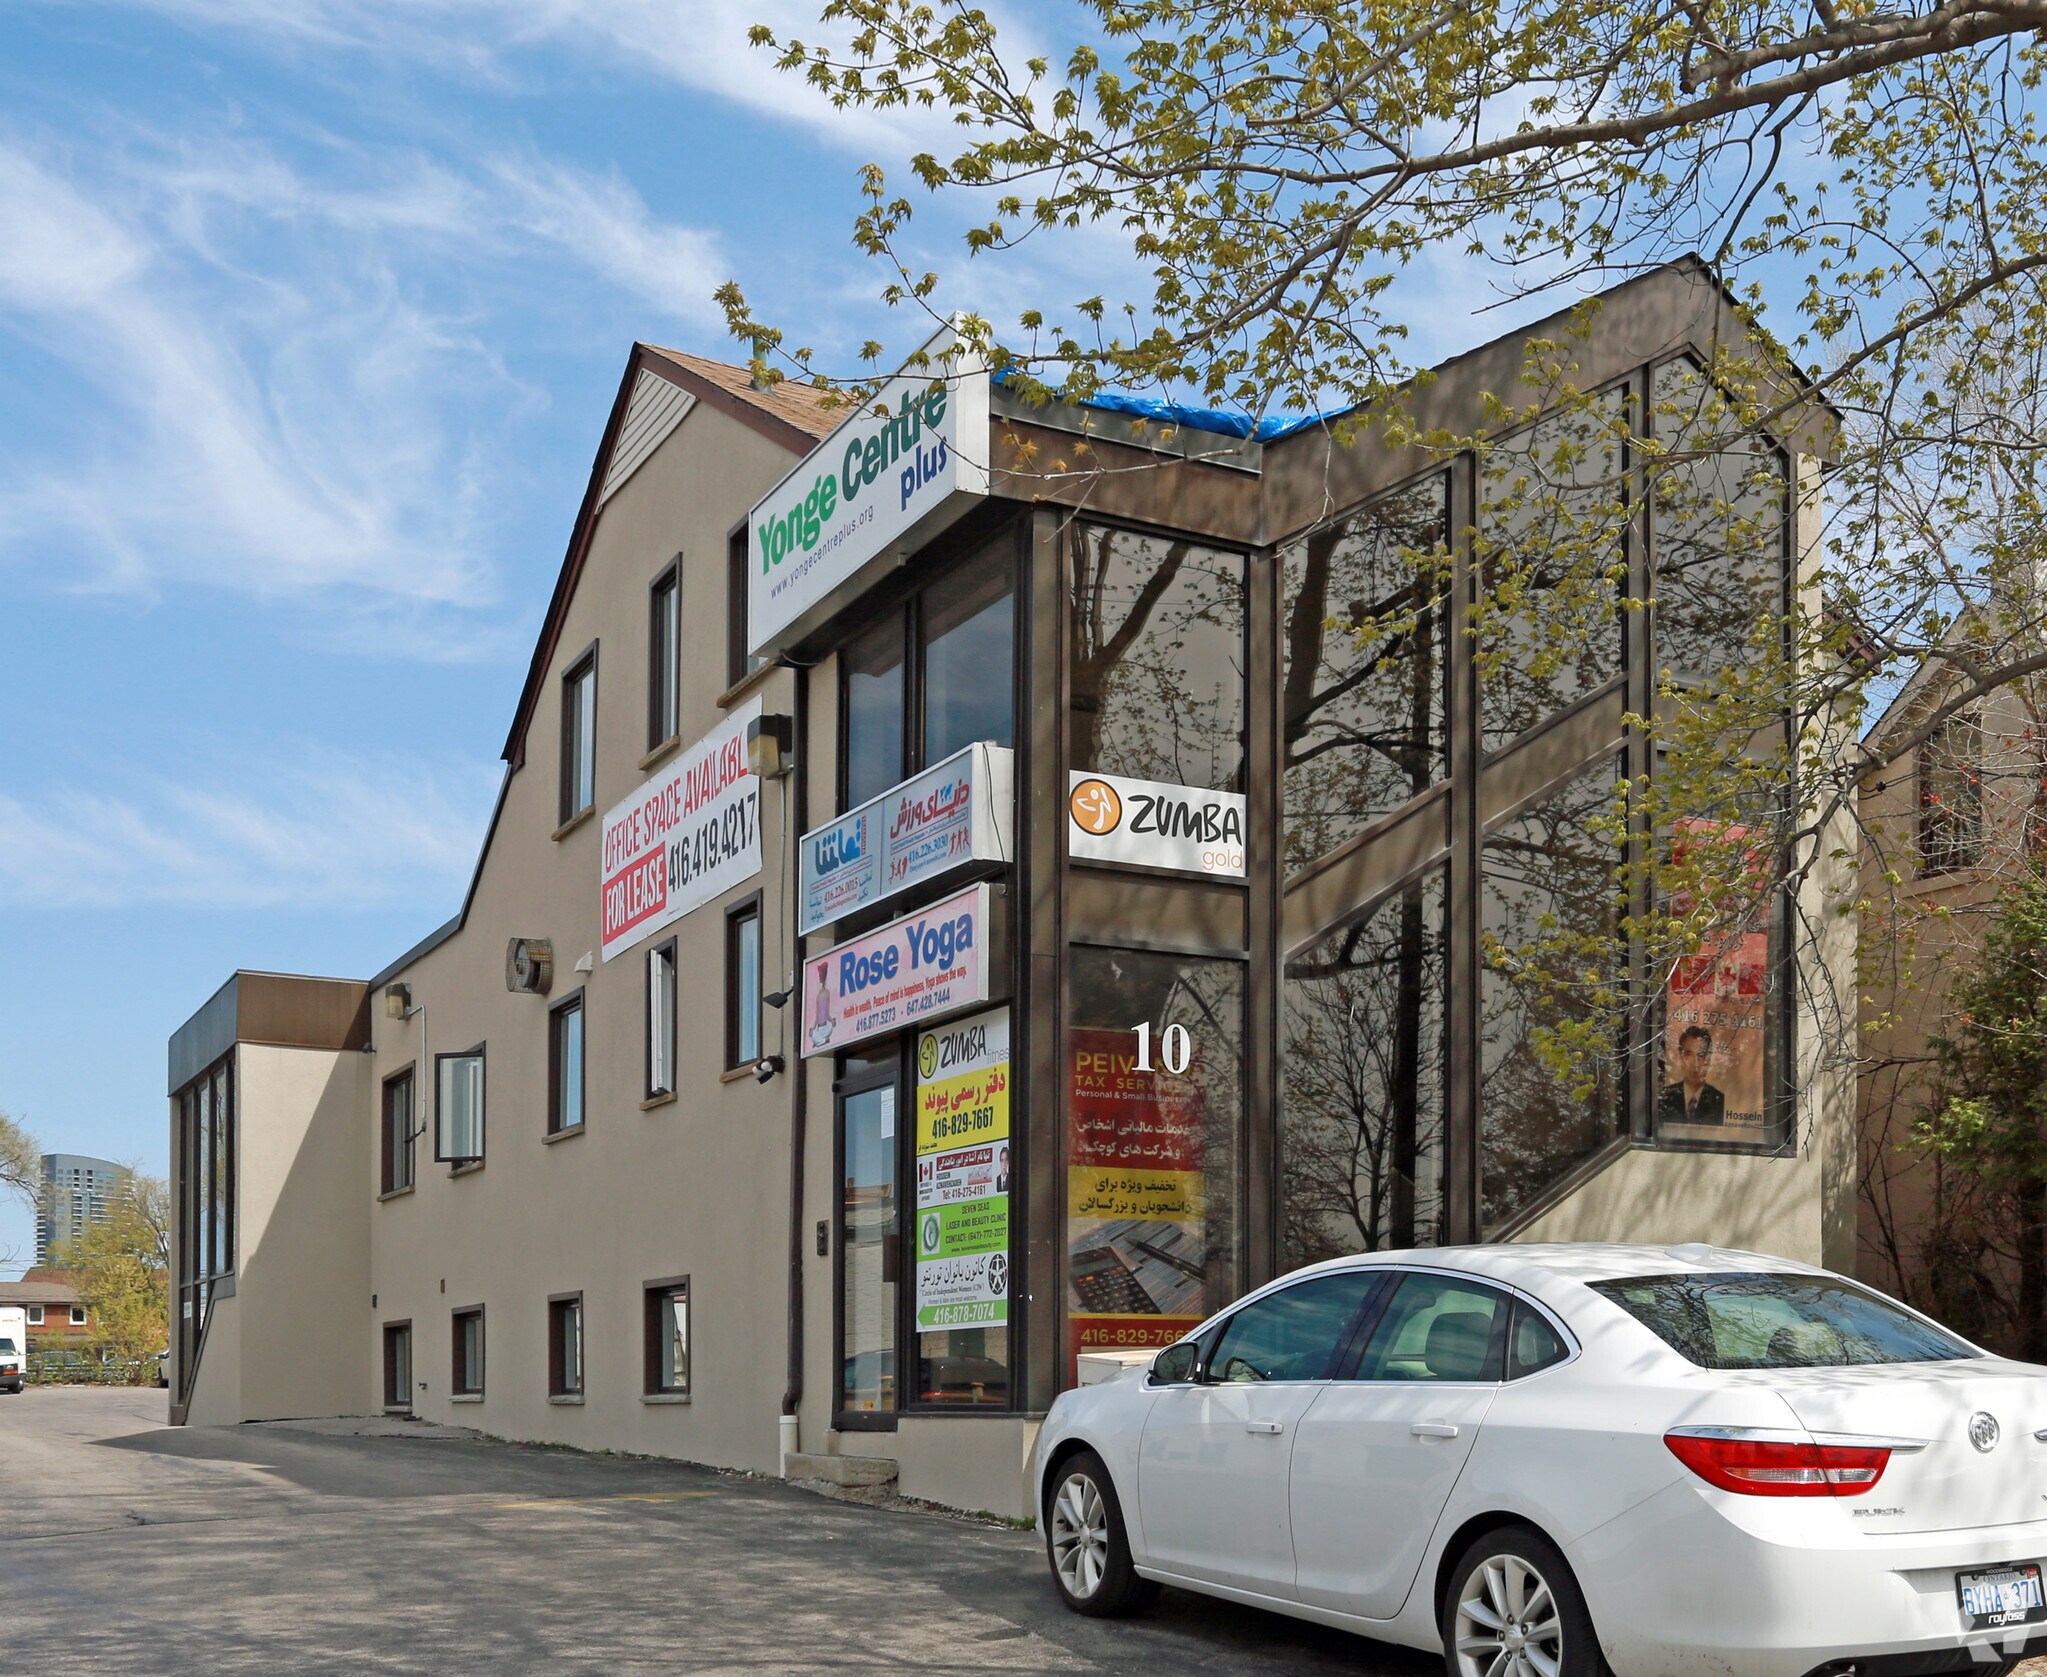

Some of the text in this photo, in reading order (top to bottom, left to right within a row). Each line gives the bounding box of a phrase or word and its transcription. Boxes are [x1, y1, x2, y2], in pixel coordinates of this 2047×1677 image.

[758, 379, 947, 576] Yonge Centre
[901, 436, 947, 512] plus
[770, 504, 874, 600] www.yongecentreplus.org
[605, 732, 748, 874] OFFICE SPACE AVAILABL
[1127, 795, 1243, 847] ZUMBA
[667, 791, 757, 894] 416.419.4217
[1202, 849, 1243, 871] gold
[606, 852, 665, 936] FOR LEASE
[840, 913, 973, 998] Rose Yoga
[889, 988, 900, 1003] mind
[949, 967, 957, 982] the
[855, 987, 951, 1034] 416.877.5273 647.428.7444
[1673, 1009, 1700, 1023] 416
[1703, 1011, 1728, 1026] 275
[940, 1024, 987, 1069] ZUMBA
[1130, 1021, 1192, 1075] 10
[983, 1067, 1006, 1104] دفتر
[1075, 1075, 1105, 1088] TAX
[925, 1086, 948, 1115] پیوند
[951, 1085, 981, 1111] رسمی
[1075, 1089, 1112, 1099] Personal
[1113, 1091, 1120, 1099] &
[1122, 1092, 1145, 1101] Small
[932, 1106, 994, 1139] 416-829-7667
[1117, 1120, 1152, 1136] مالیاتی
[1725, 1110, 1763, 1122] Hossein
[1119, 1143, 1142, 1158] های
[1143, 1143, 1173, 1160] شرکت
[942, 1189, 951, 1201] Tel:
[952, 1185, 986, 1199] 416-275-4161
[1095, 1177, 1176, 1194] تخفیف ویژه برای
[962, 1202, 990, 1215] SEVEN SEAS
[1131, 1202, 1137, 1214] و
[1139, 1200, 1191, 1215] دانشجویان
[946, 1213, 1007, 1230] LASER AND BEAUTY CLINIC
[921, 1255, 986, 1287] کانون بانوان تورنتو
[933, 1302, 995, 1324] 416-878-7074
[1080, 1328, 1190, 1343] 416-829-766
[1983, 1572, 2016, 1584] ONTARIO
[1963, 1580, 2041, 1615] BYHA 371
[1988, 1610, 2026, 1626] royfoss
